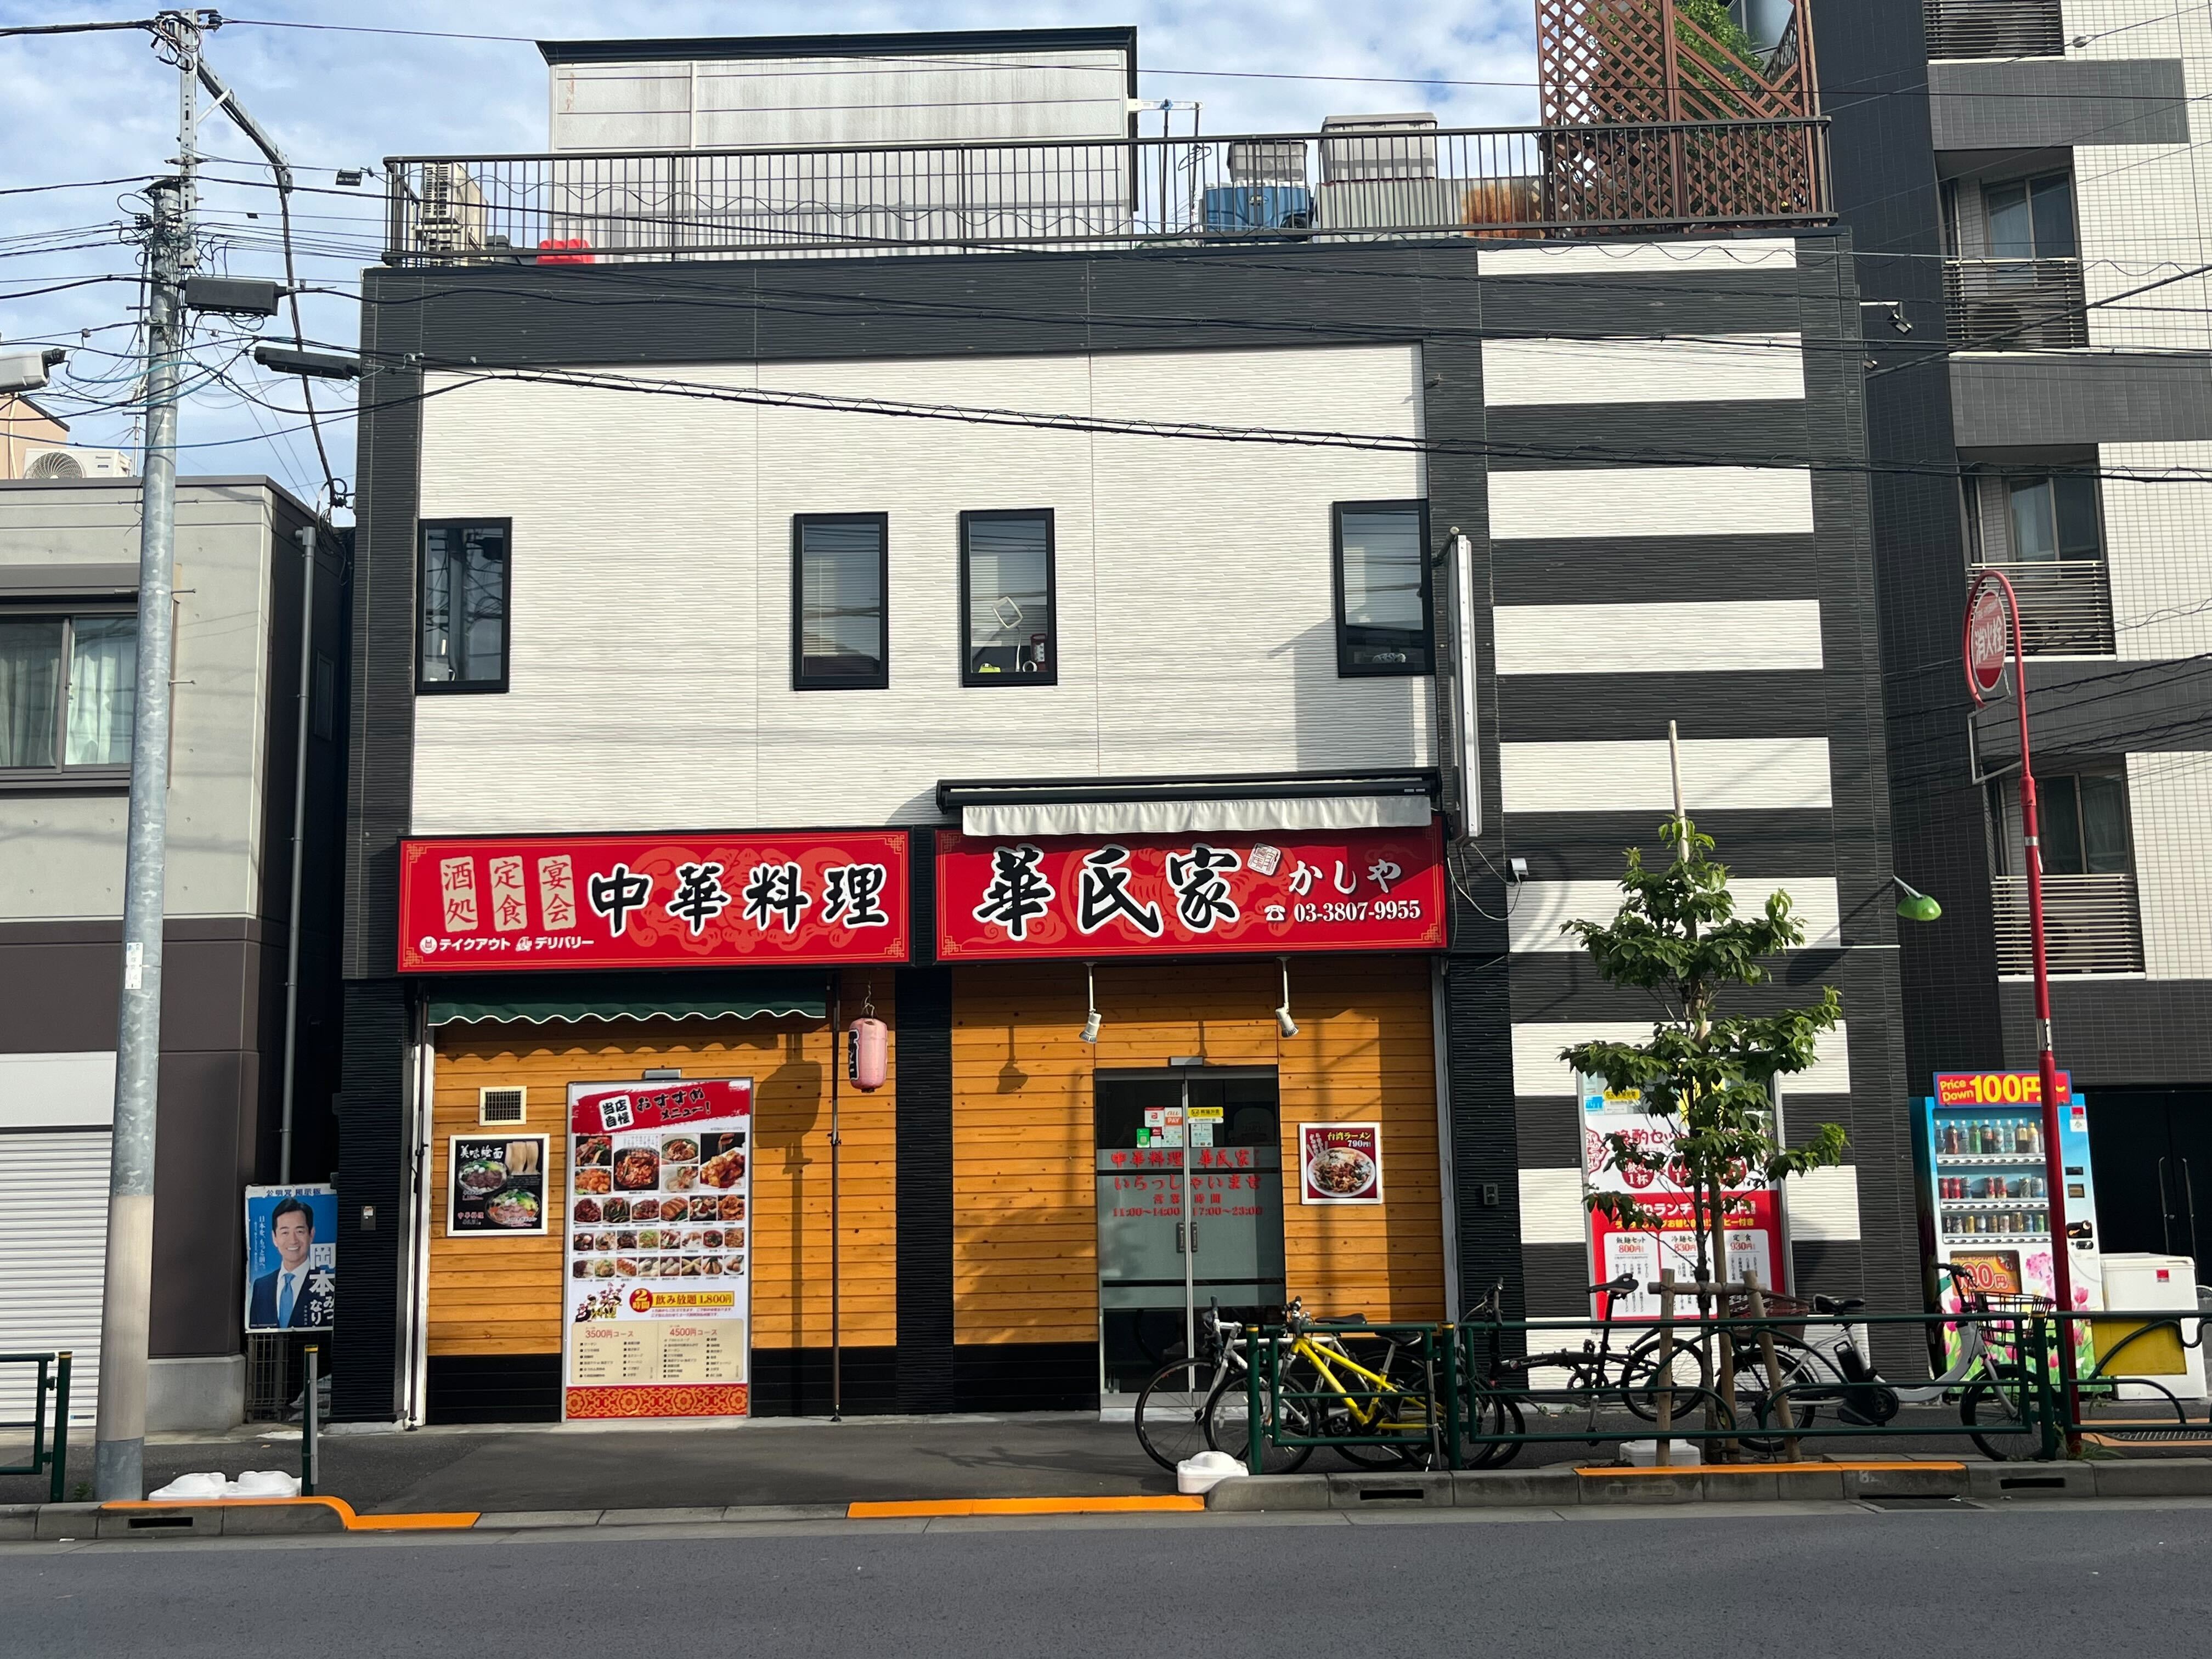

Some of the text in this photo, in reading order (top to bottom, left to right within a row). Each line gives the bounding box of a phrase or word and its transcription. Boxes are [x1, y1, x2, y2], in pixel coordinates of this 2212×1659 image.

[1974, 616, 2003, 665] 消火栓
[1289, 859, 1401, 895] かしや
[444, 861, 476, 924] 酒処
[492, 861, 526, 923] 定食
[540, 860, 574, 922] 宴会
[590, 862, 888, 935] 中華料理
[973, 844, 1242, 939] 華氏家
[1294, 900, 1420, 922] 03-3807-9955
[439, 936, 511, 951] テイクアウト
[535, 936, 594, 950] デリバリー
[1940, 1079, 1967, 1091] Price
[637, 1088, 705, 1112] おすすめ
[1942, 1089, 1974, 1103] Down
[602, 1099, 627, 1115] 当店
[606, 1112, 630, 1127] 自慢
[1111, 1150, 1184, 1168] 中華料理
[1199, 1149, 1250, 1169] 華氏家
[1733, 1233, 1751, 1242] 定食
[309, 1243, 336, 1296] 岡本
[635, 1289, 648, 1301] 2
[656, 1294, 732, 1305] 飲み放題 1,800円
[632, 1300, 650, 1310] 時間
[585, 1329, 634, 1339] 3500円コース
[669, 1327, 718, 1336] 4500円コース
